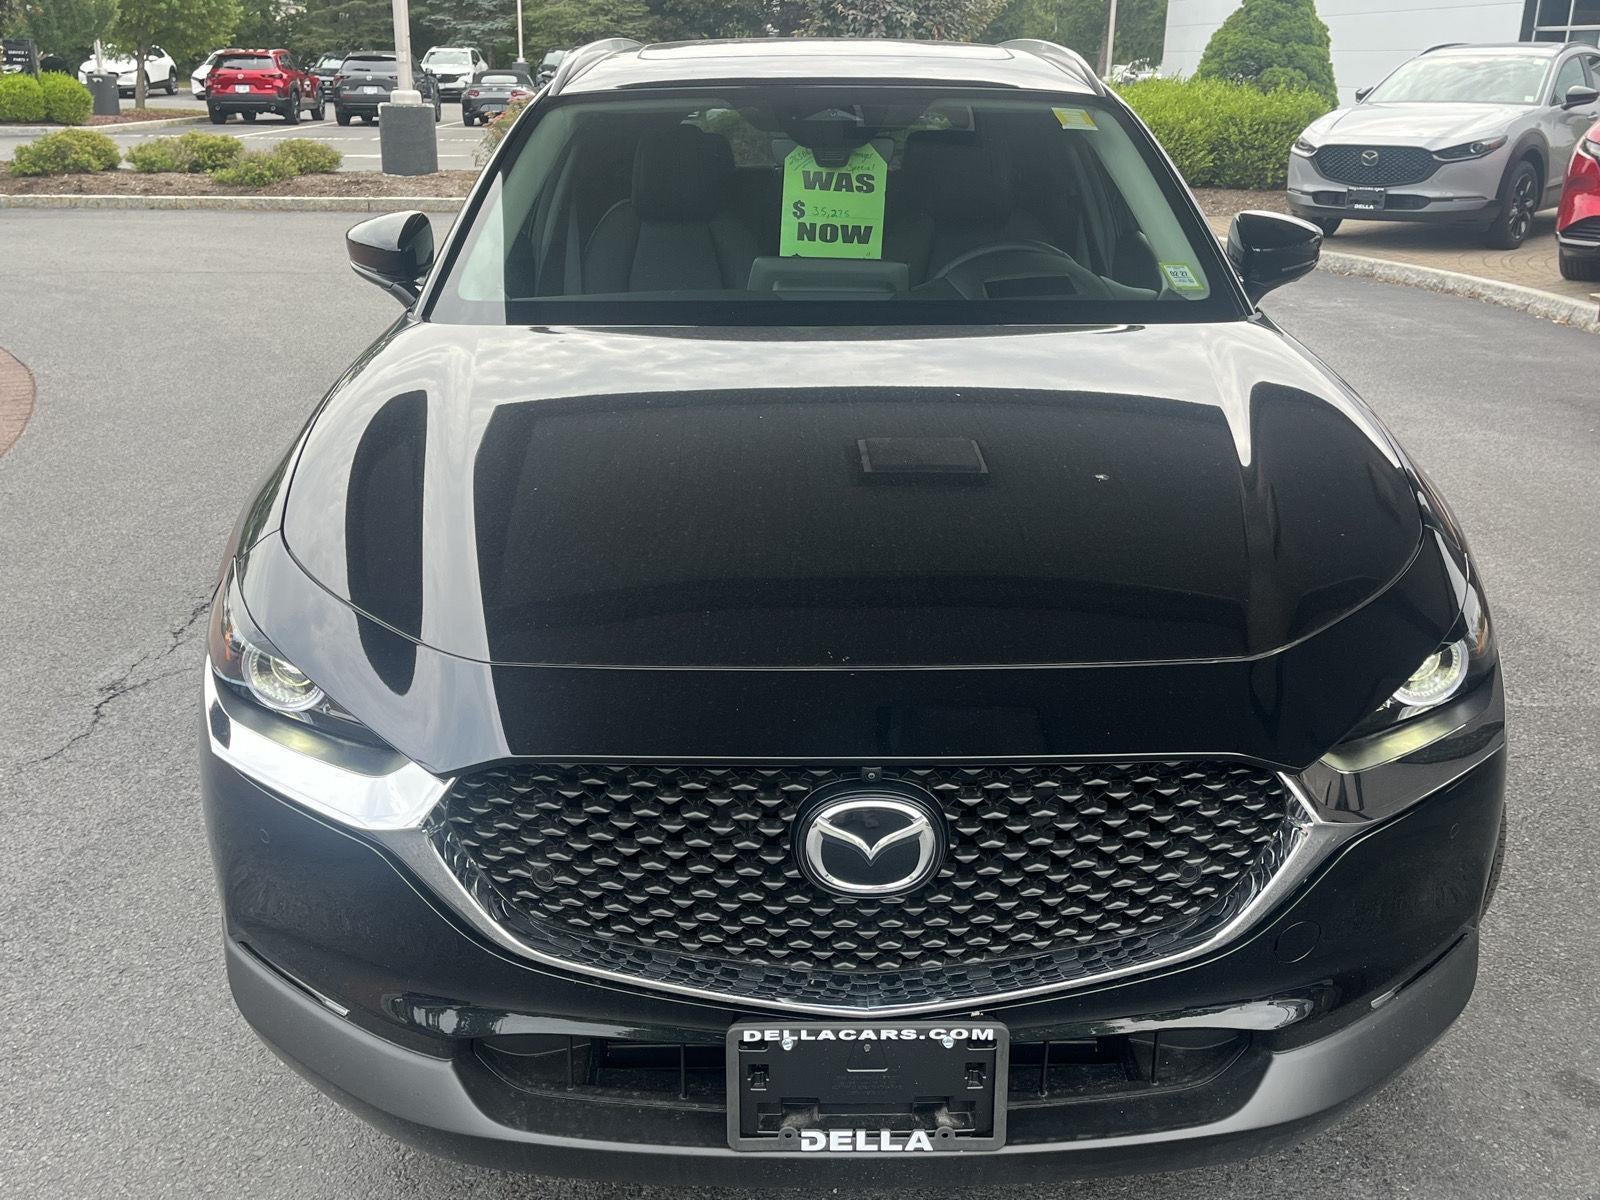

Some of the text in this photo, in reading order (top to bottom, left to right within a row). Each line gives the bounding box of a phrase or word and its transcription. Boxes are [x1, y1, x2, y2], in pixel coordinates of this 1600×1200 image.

[802, 170, 875, 193] WAS
[792, 200, 805, 219] $
[797, 222, 873, 244] NOW
[743, 1028, 994, 1042] DELLACARS.COM
[800, 1131, 933, 1151] DELLA
